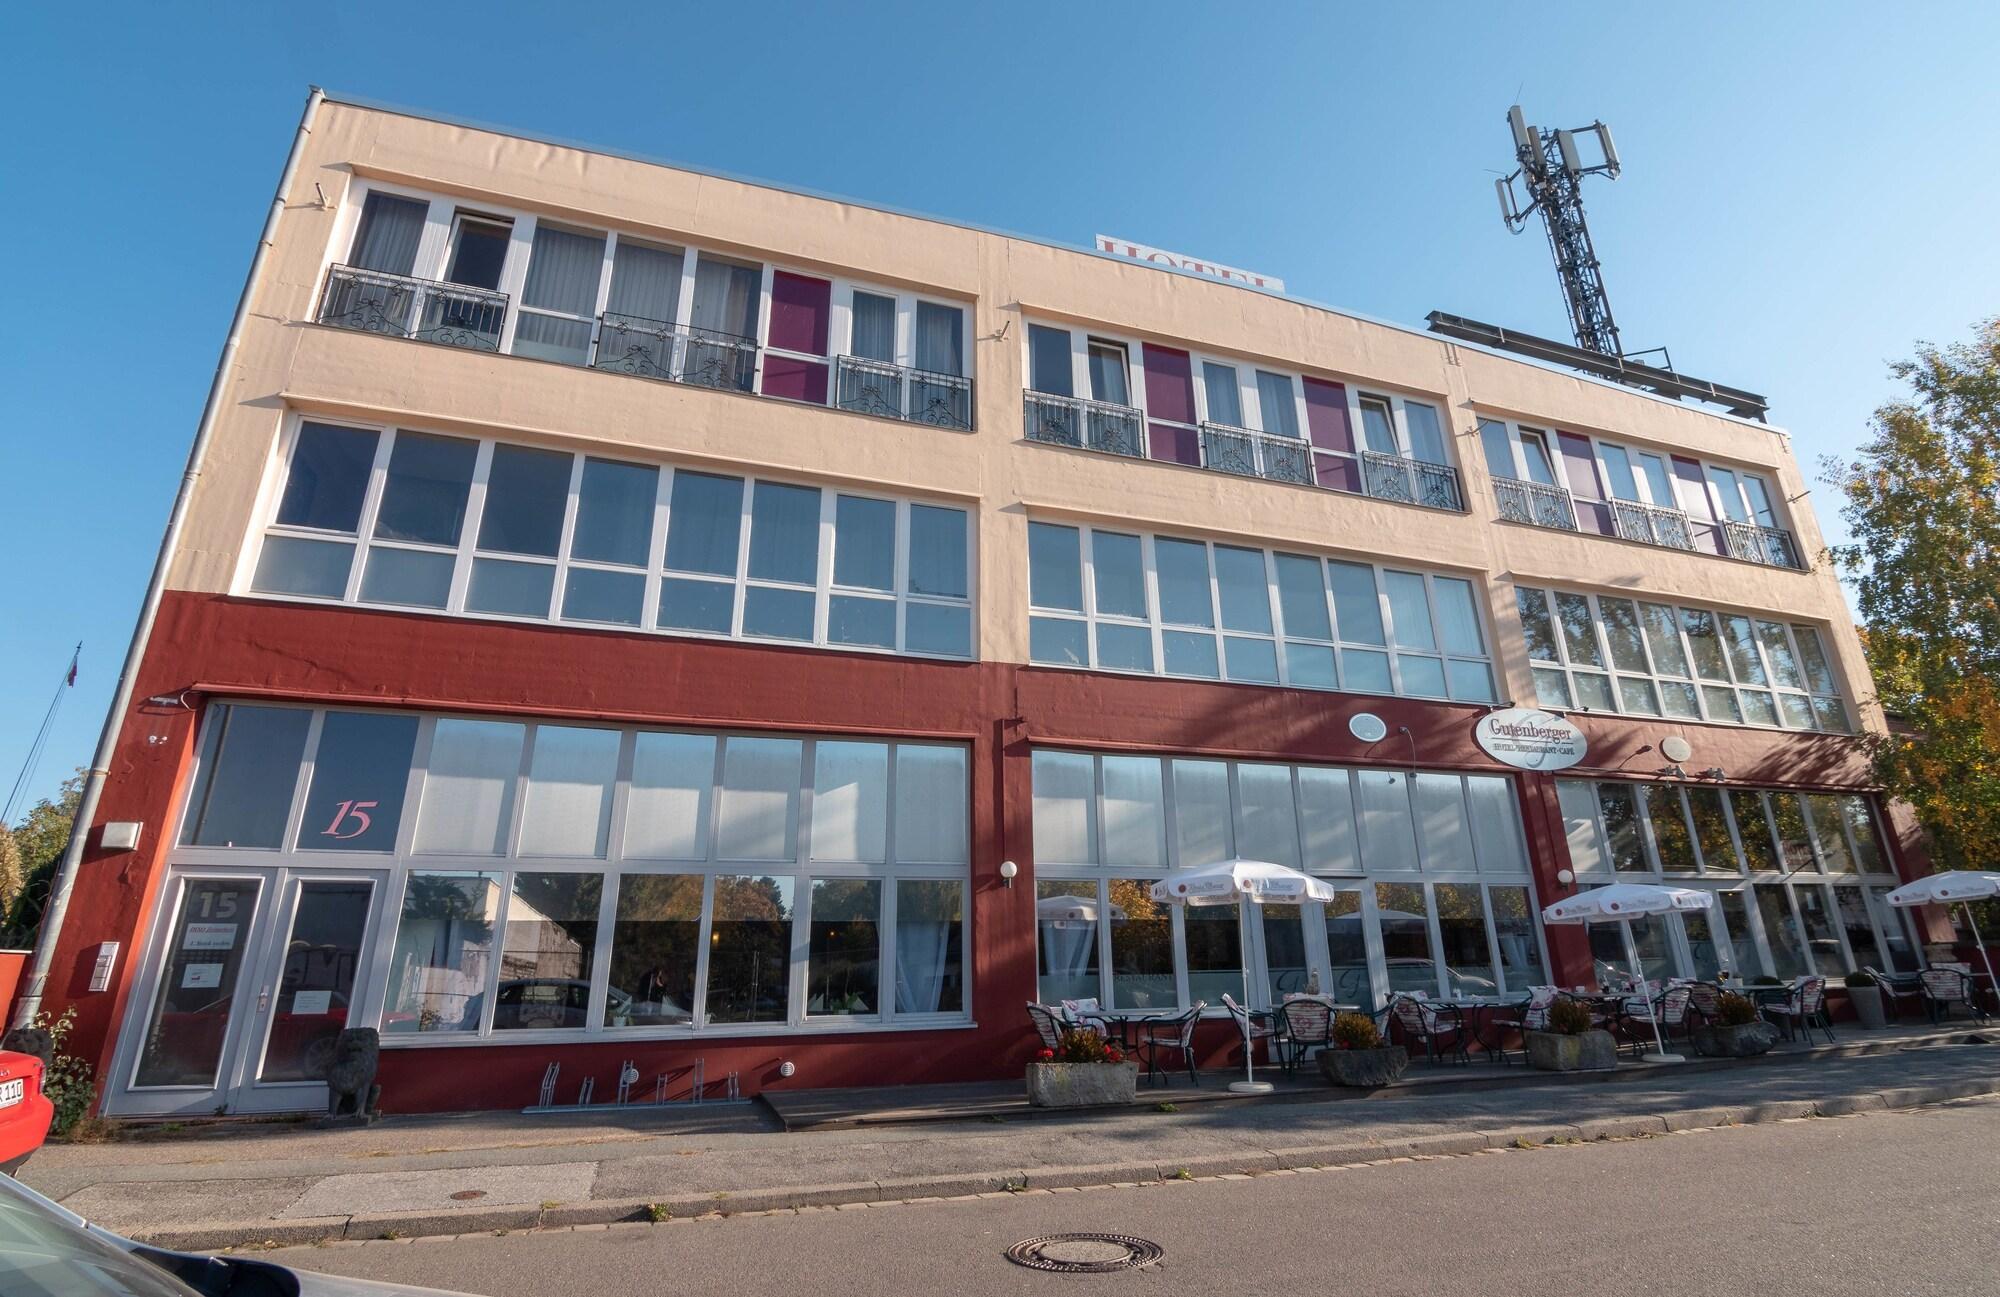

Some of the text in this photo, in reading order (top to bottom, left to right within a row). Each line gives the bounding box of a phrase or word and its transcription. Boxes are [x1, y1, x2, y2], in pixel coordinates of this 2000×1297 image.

[1490, 718, 1571, 744] Gutenberger
[320, 800, 378, 839] 15
[200, 891, 238, 919] 15
[5, 1081, 22, 1101] 110
